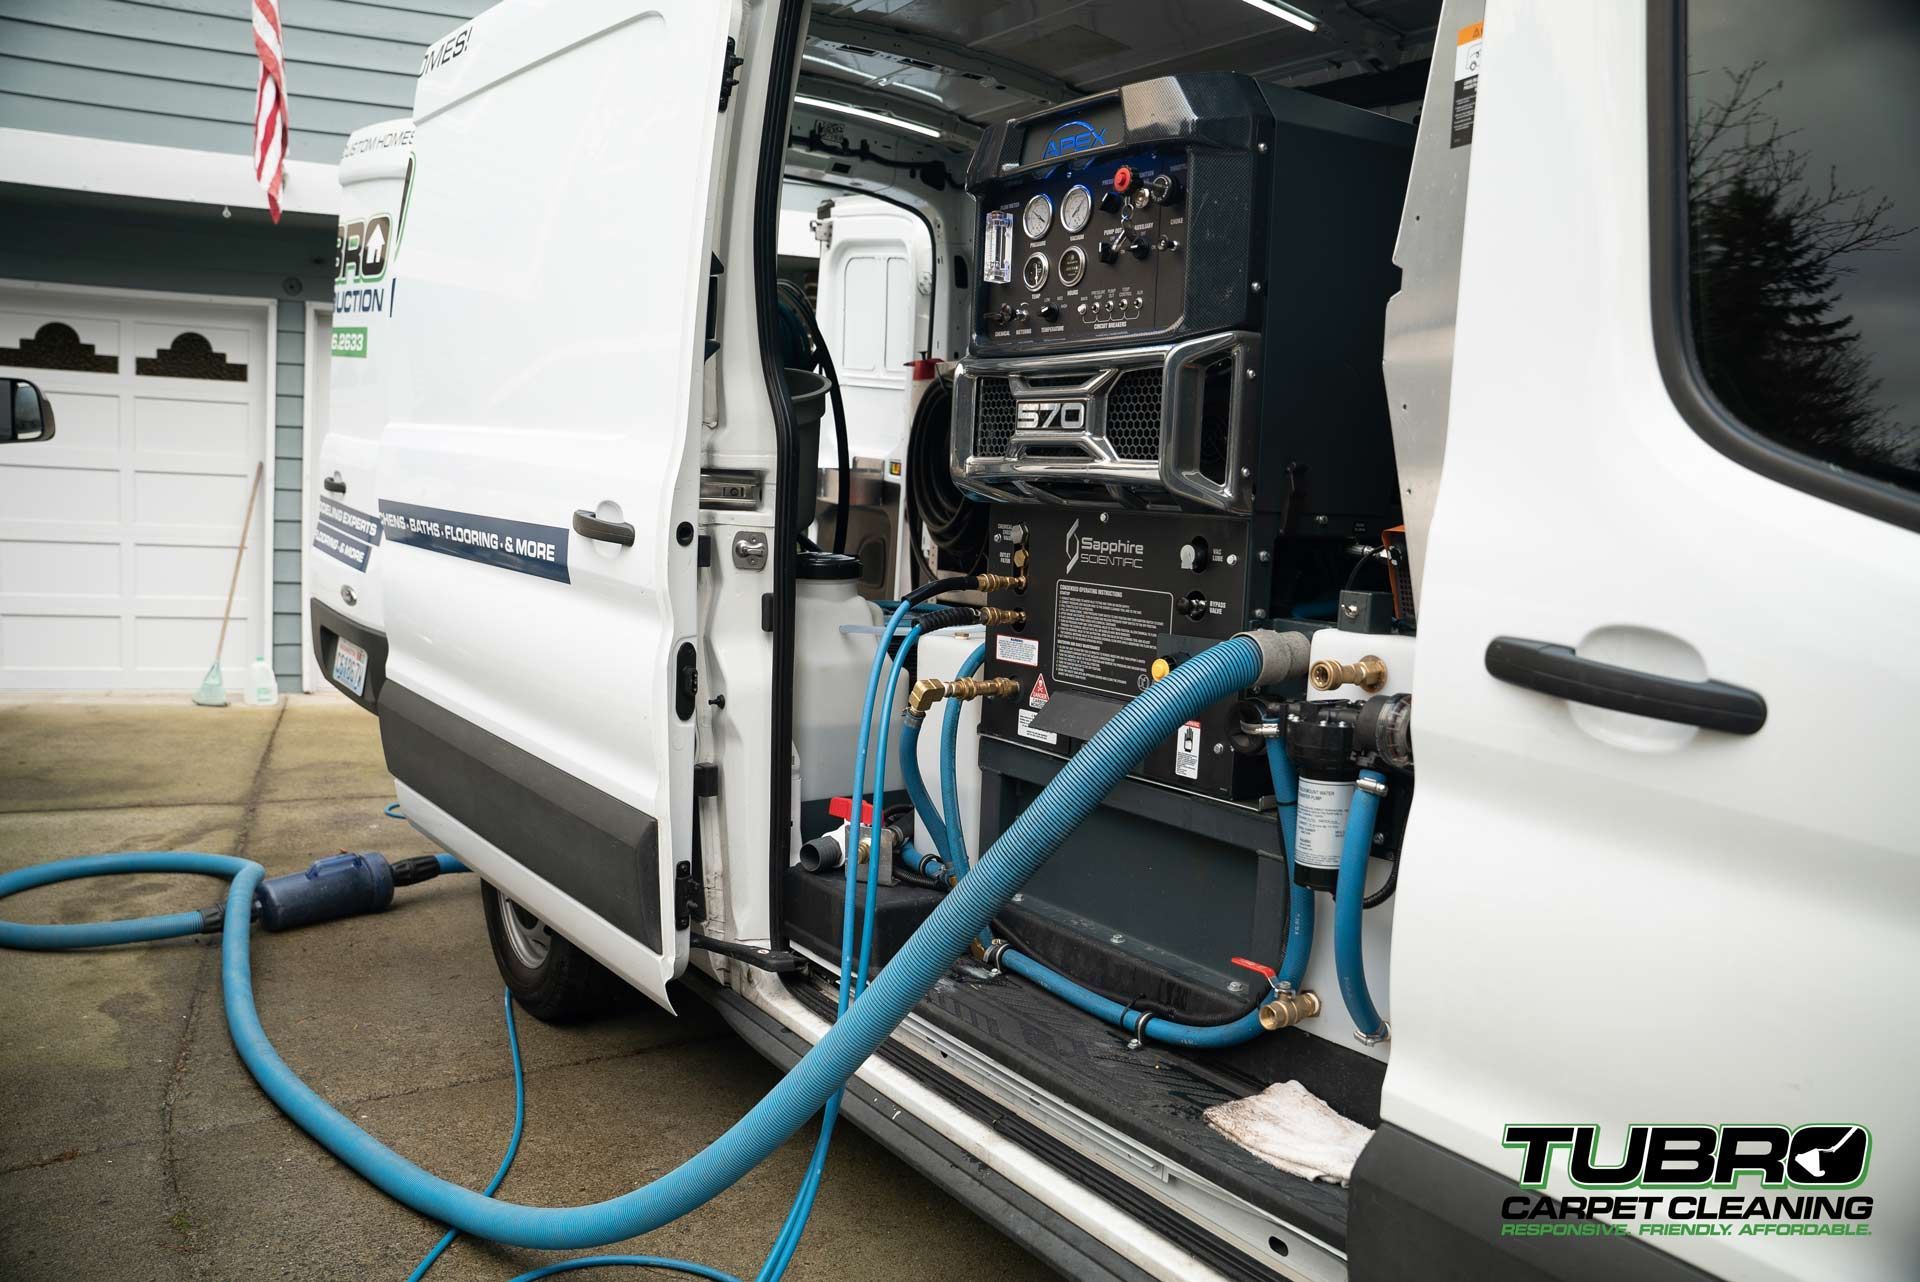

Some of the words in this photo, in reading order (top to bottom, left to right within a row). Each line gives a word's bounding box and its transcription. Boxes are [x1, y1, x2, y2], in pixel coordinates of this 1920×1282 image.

[1042, 127, 1107, 160] APEX
[332, 333, 364, 352] 6.2633
[342, 511, 378, 537] EXPERTS
[410, 518, 441, 538] BATHS
[445, 525, 499, 550] FLOORING
[504, 538, 514, 553] &
[515, 538, 556, 562] MORE
[1081, 537, 1144, 555] Sapphire
[1080, 553, 1144, 569] SCIENTIFIC
[1209, 600, 1226, 608] BYPASS
[1209, 607, 1223, 615] VALVE
